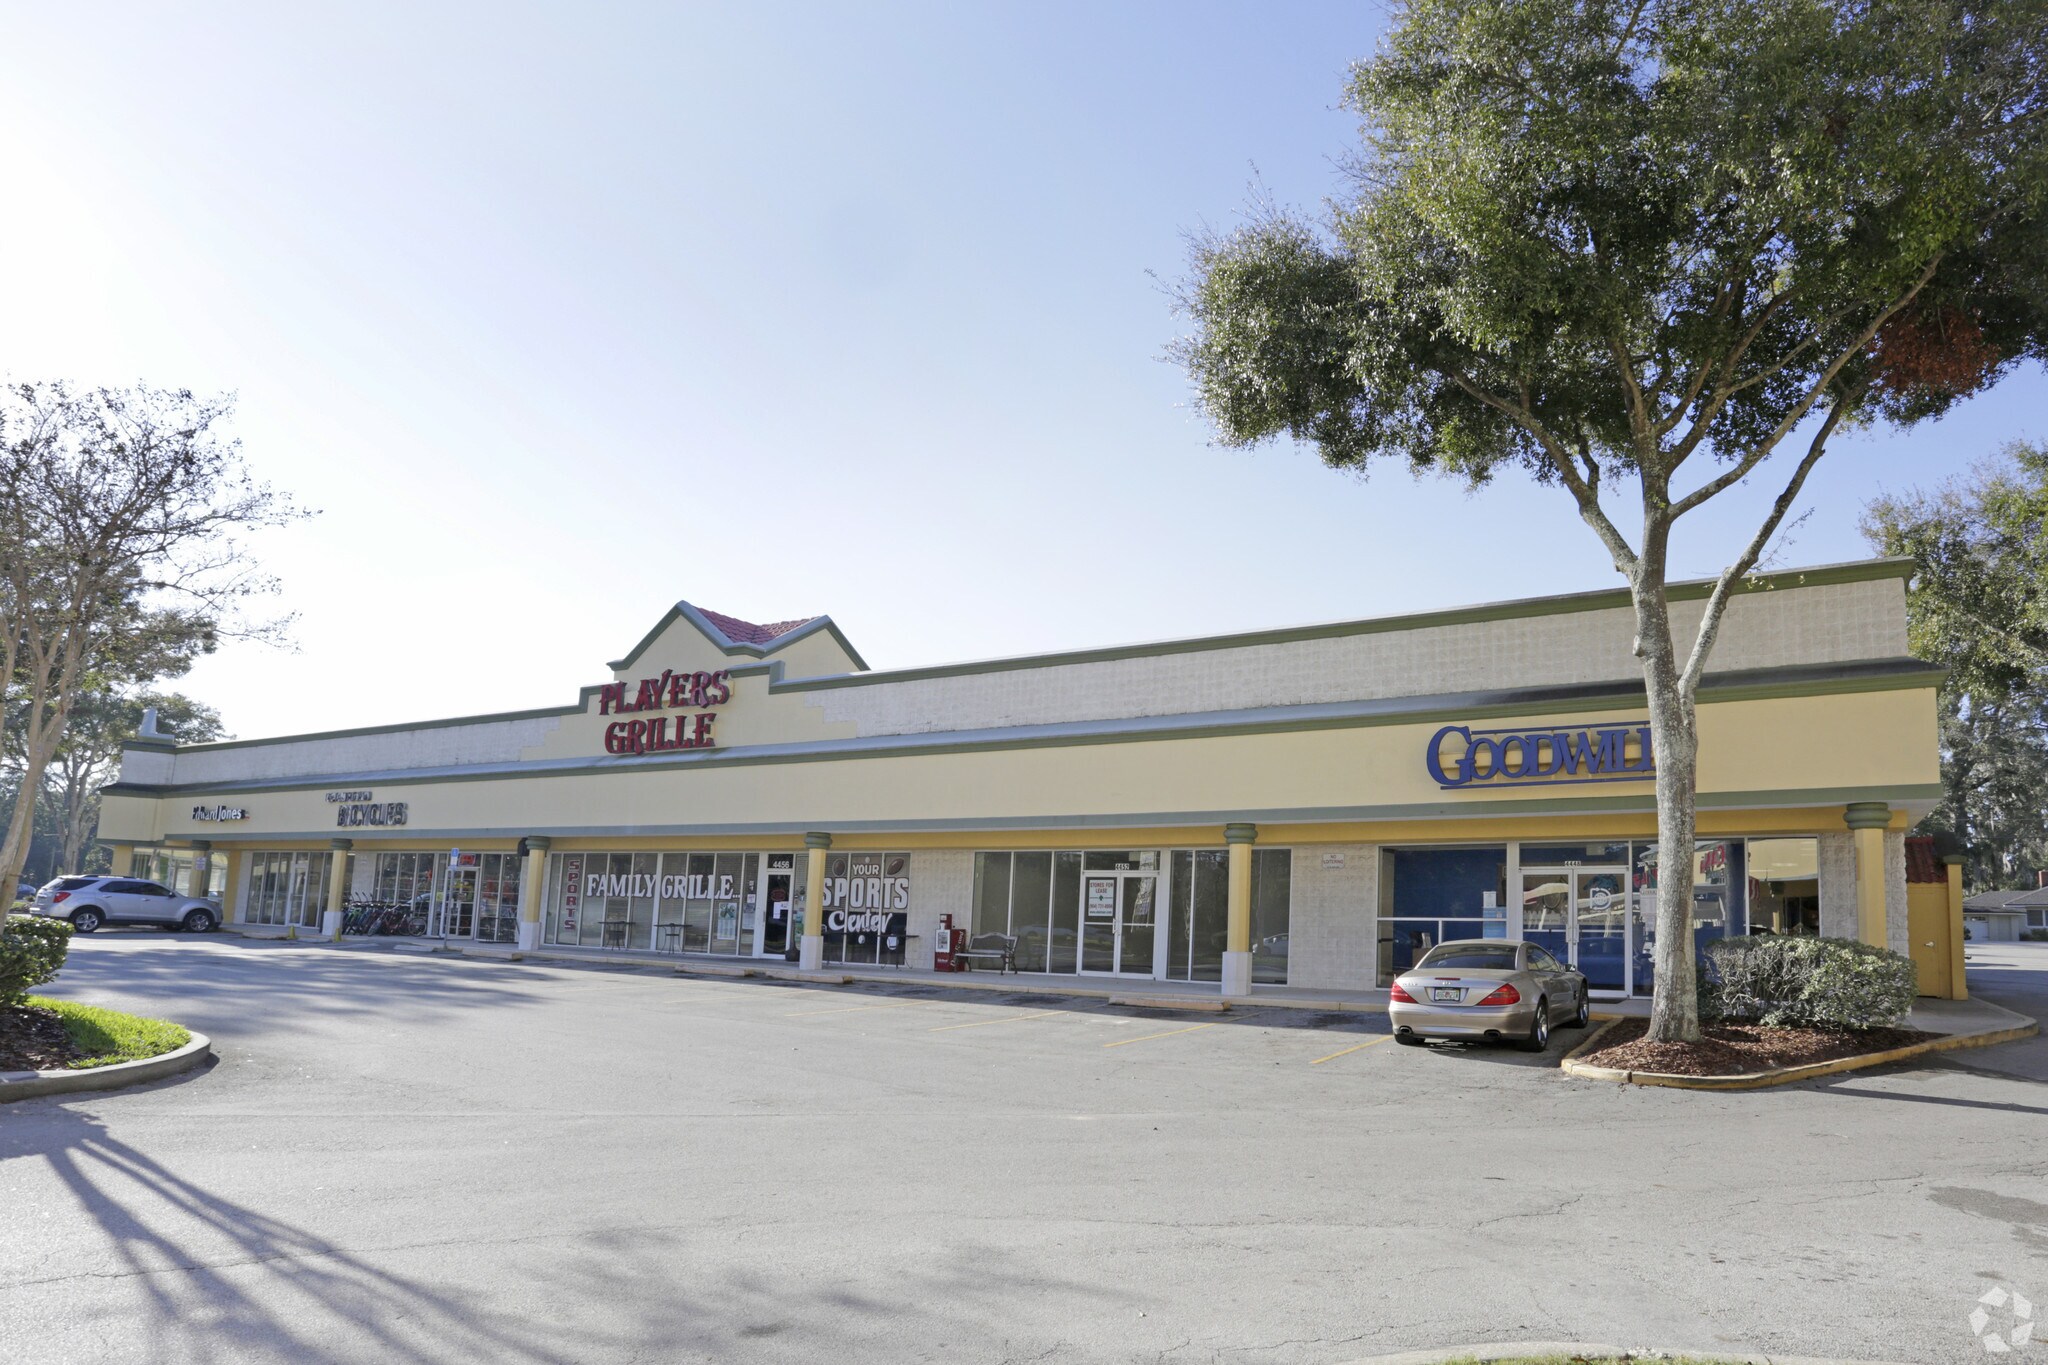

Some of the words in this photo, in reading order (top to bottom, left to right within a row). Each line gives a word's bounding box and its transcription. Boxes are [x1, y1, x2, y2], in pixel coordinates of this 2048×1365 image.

[599, 669, 729, 715] PLAYERS
[605, 713, 717, 754] GRILLE
[337, 803, 408, 827] BICYCLES
[773, 861, 790, 869] 4456
[853, 864, 880, 875] YOUR
[564, 860, 580, 931] SPORTS
[587, 873, 657, 897] FAMILY
[822, 877, 909, 909] SPORTS
[828, 908, 893, 933] Center
